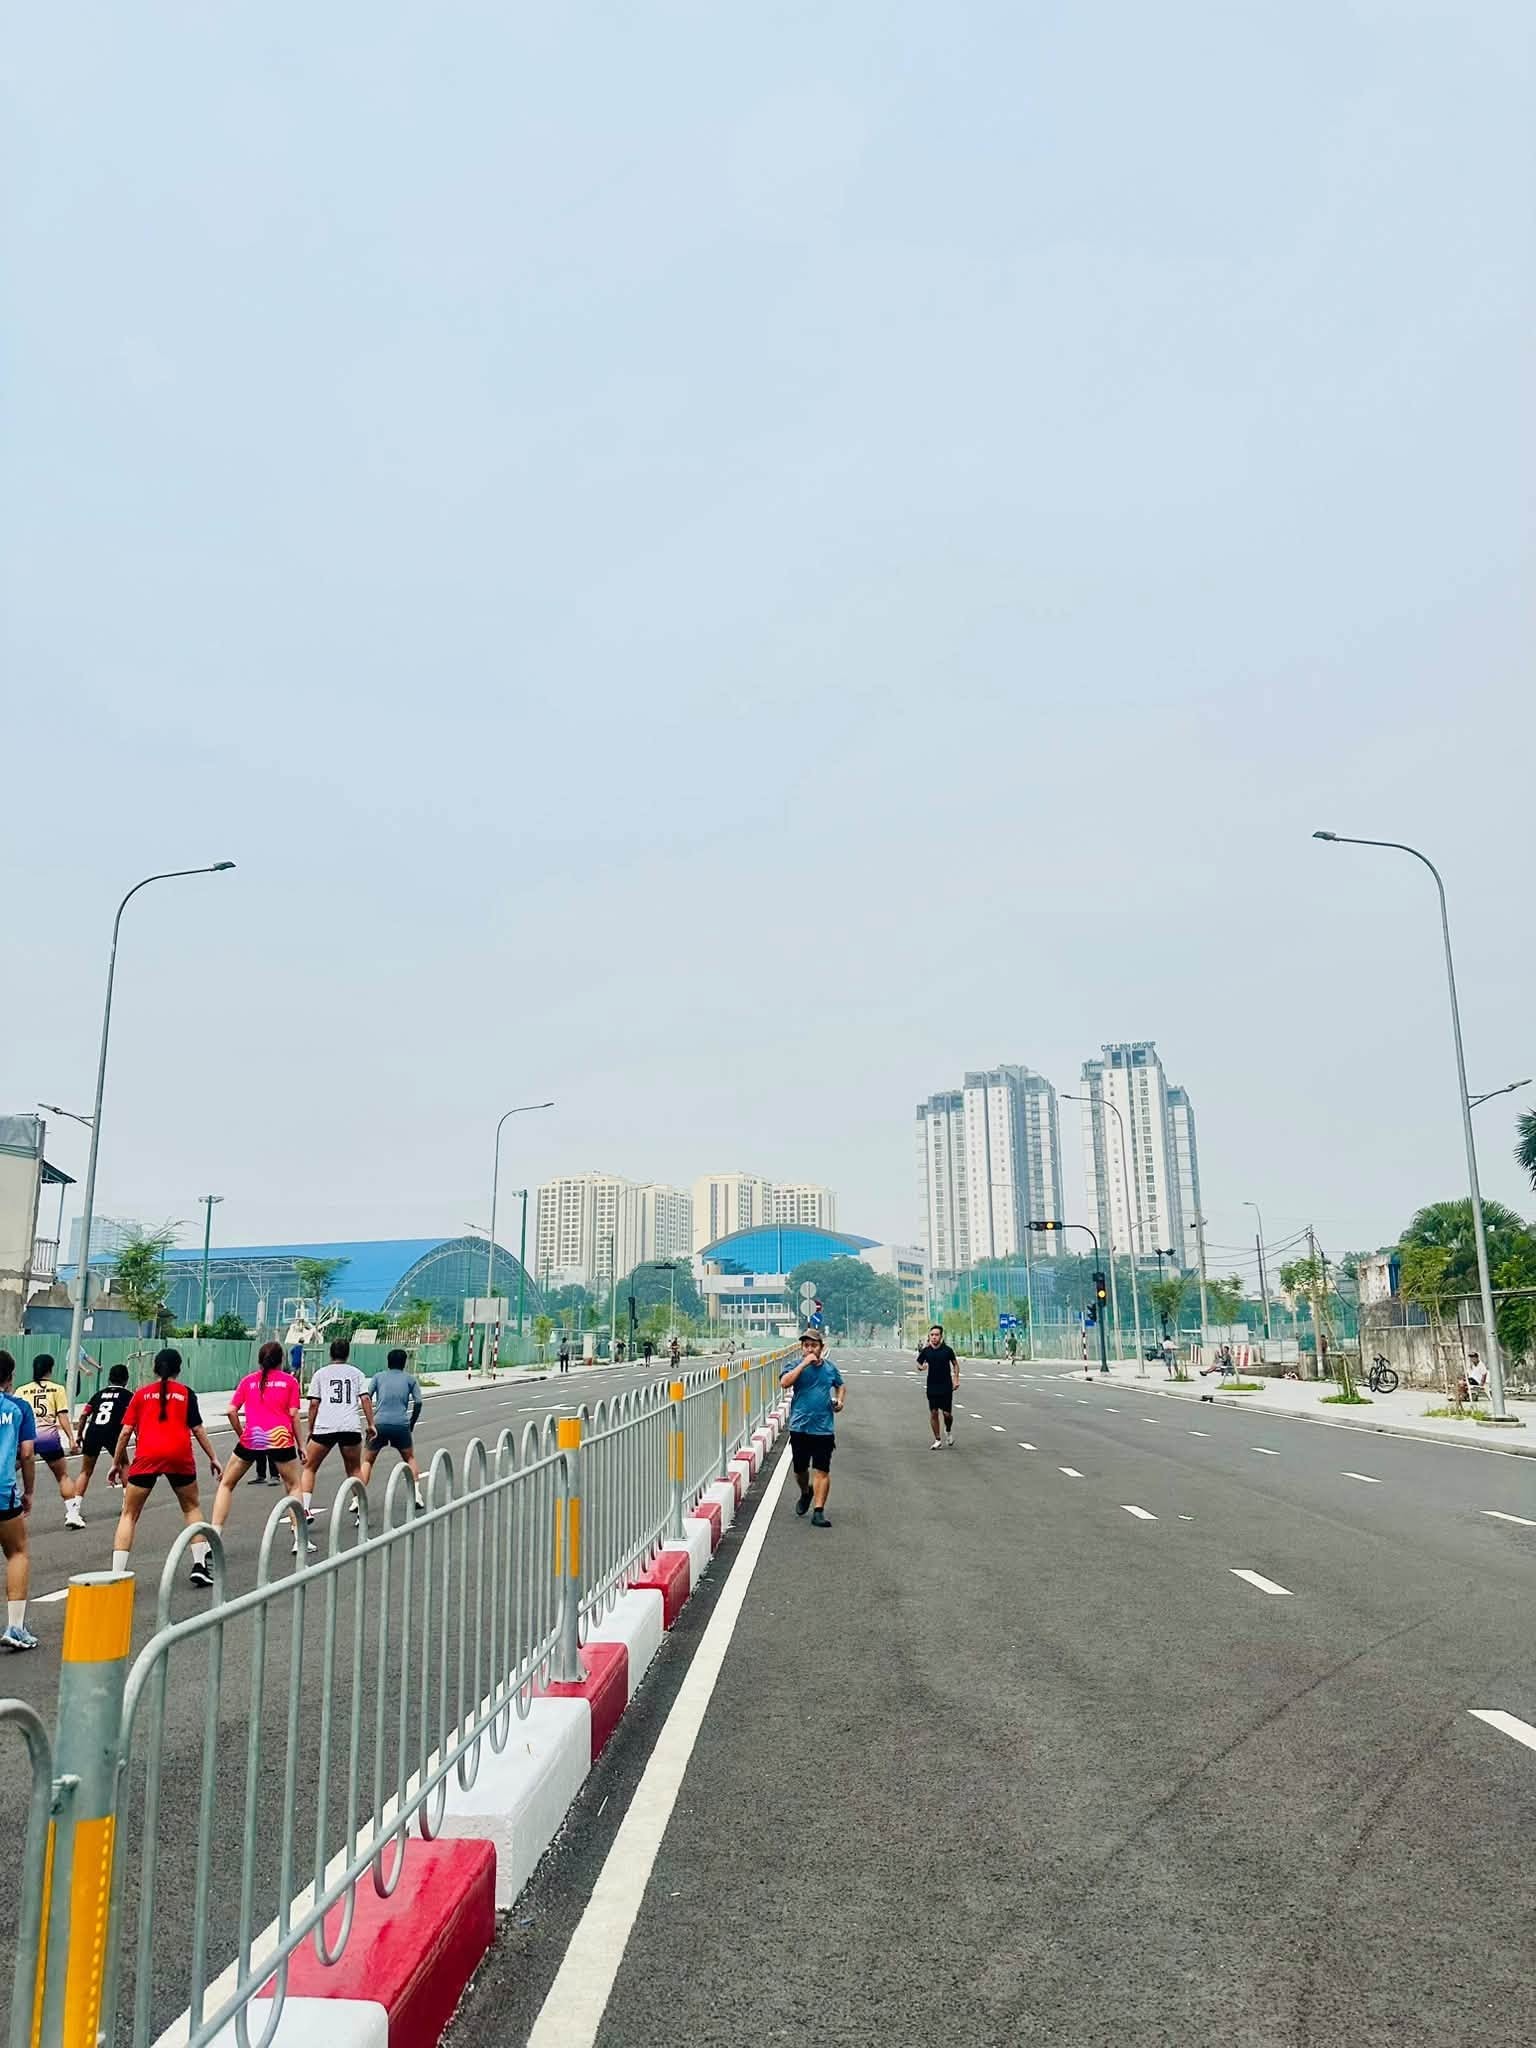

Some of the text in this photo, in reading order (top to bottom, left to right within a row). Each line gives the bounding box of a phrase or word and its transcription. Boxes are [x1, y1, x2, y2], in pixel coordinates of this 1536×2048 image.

[1132, 1041, 1156, 1049] GROUP
[330, 1379, 351, 1404] 31
[33, 1394, 48, 1418] 5
[95, 1401, 114, 1425] 8
